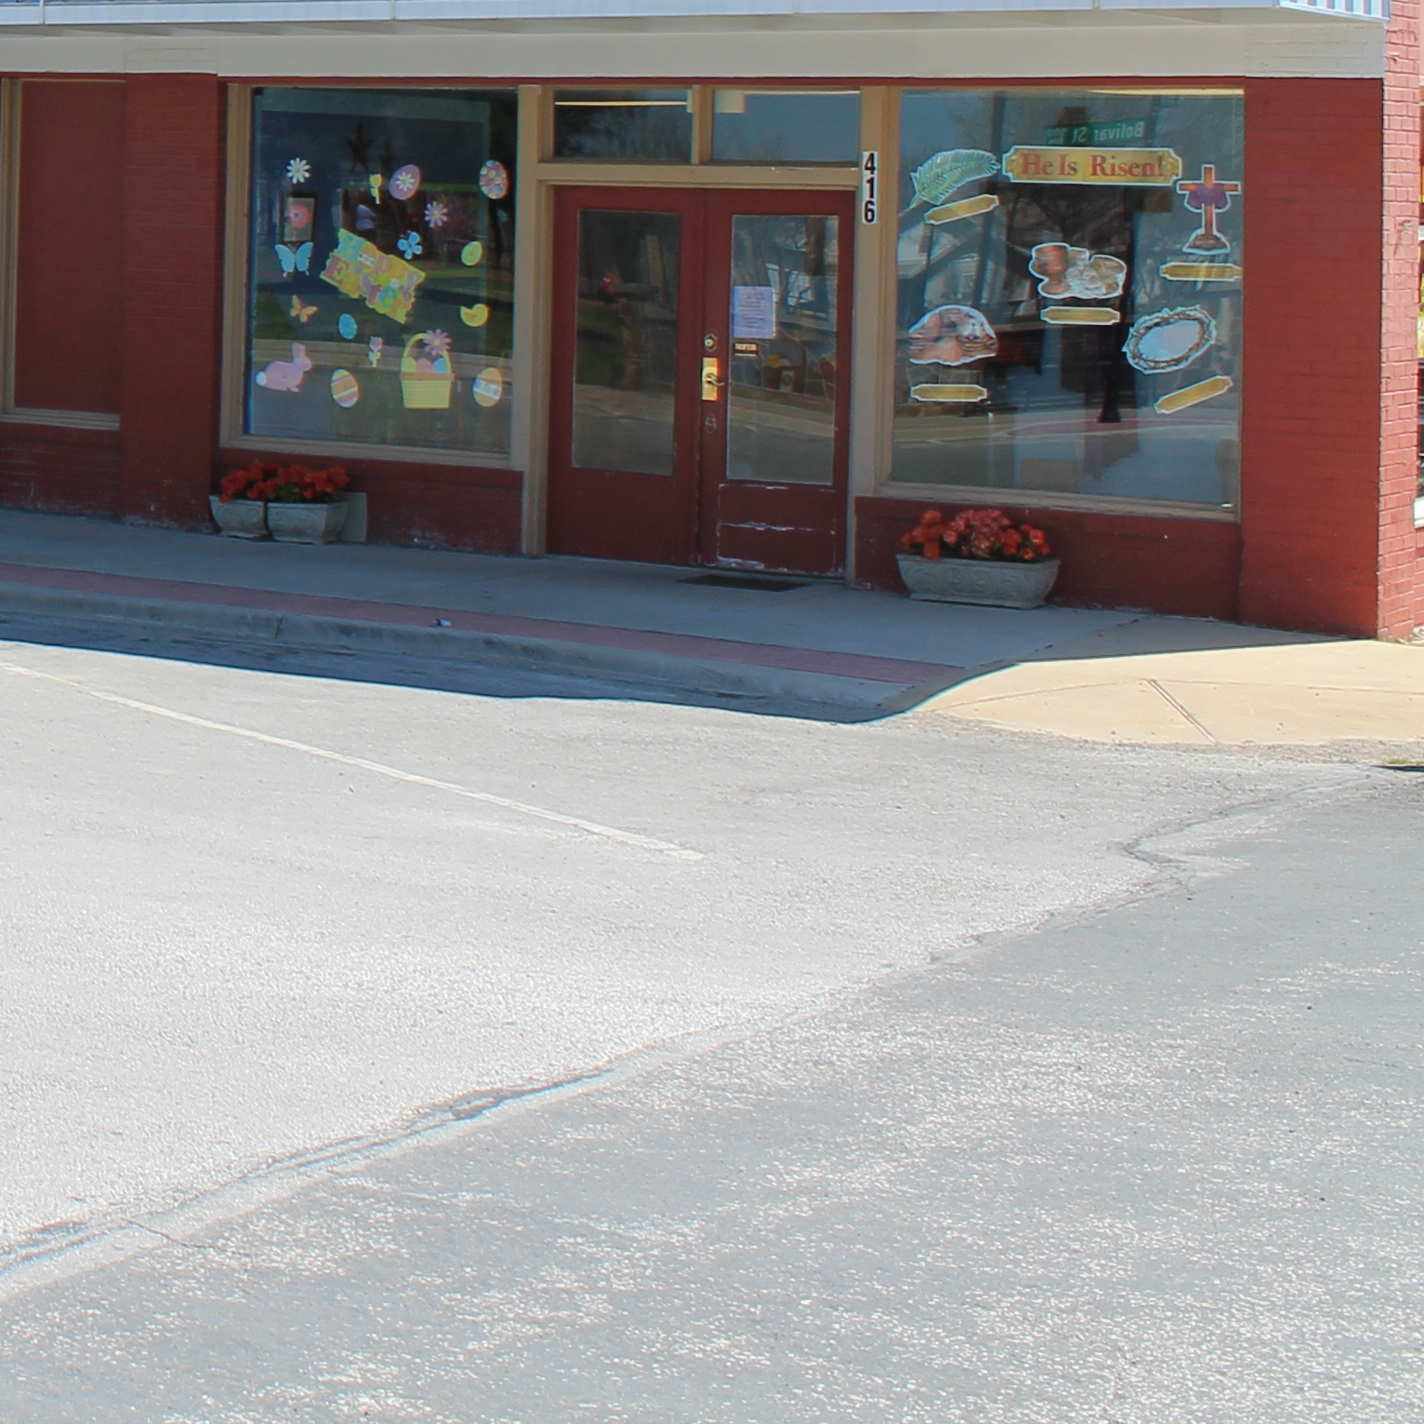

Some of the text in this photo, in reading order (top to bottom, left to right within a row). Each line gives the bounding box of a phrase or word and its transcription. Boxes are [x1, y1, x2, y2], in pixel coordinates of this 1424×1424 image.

[864, 152, 876, 223] 416
[1022, 153, 1164, 177] He Is Risen!
